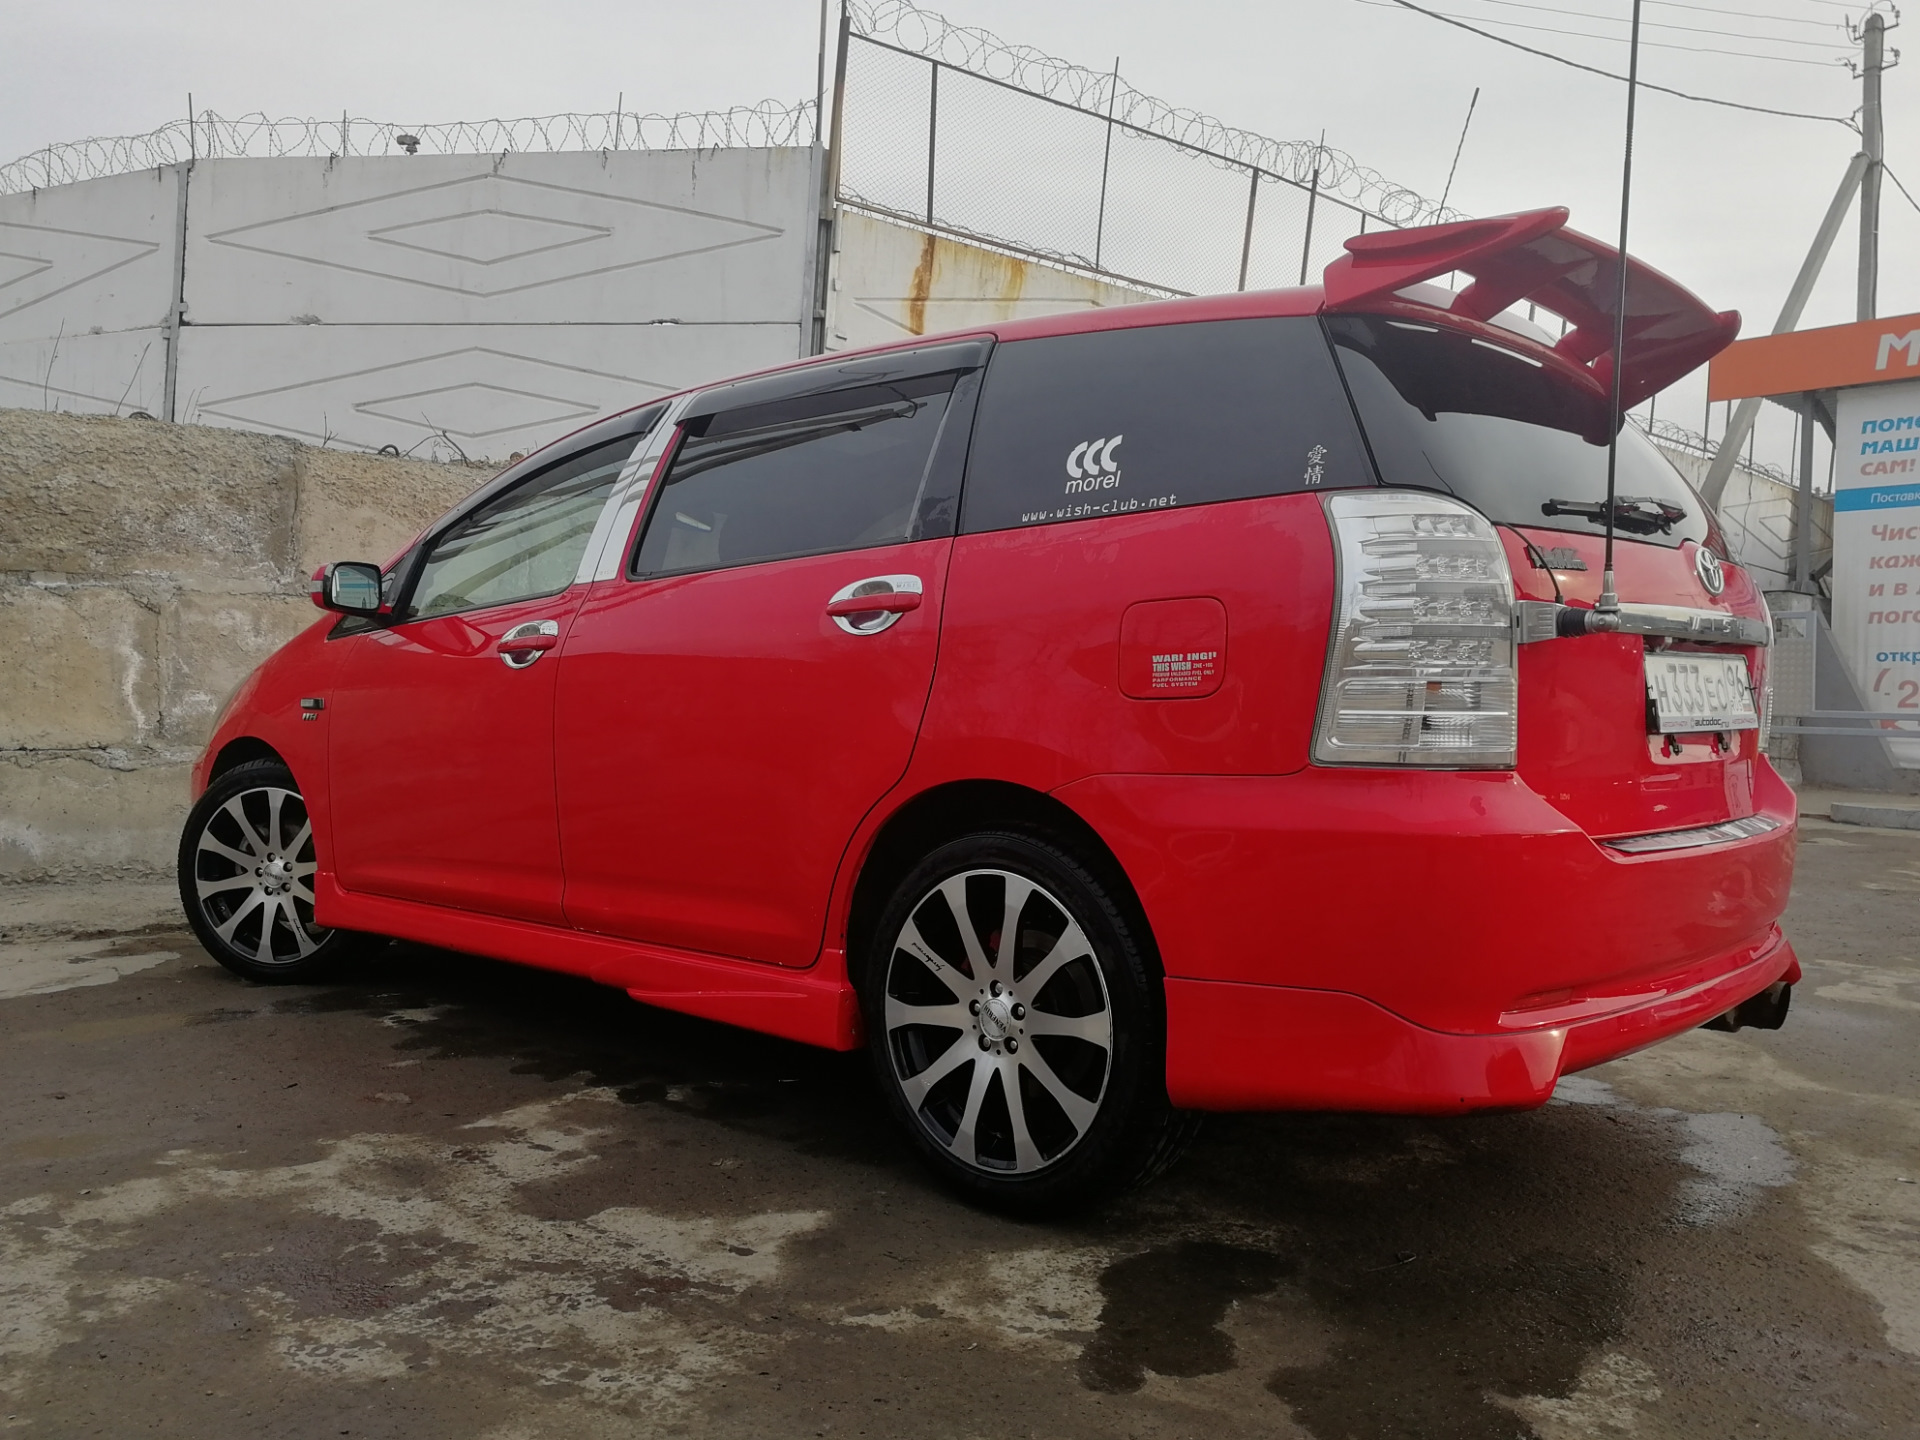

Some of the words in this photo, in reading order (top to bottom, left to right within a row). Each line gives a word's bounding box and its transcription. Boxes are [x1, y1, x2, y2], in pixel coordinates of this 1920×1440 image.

[1860, 458, 1916, 476] САМ!
[1065, 470, 1121, 494] morel
[1021, 494, 1177, 522] www.wish-club.net
[1871, 524, 1920, 541] Чис
[1868, 583, 1885, 597] и
[1893, 583, 1908, 596] в
[1152, 663, 1169, 672] THIS
[1171, 661, 1192, 671] WISH
